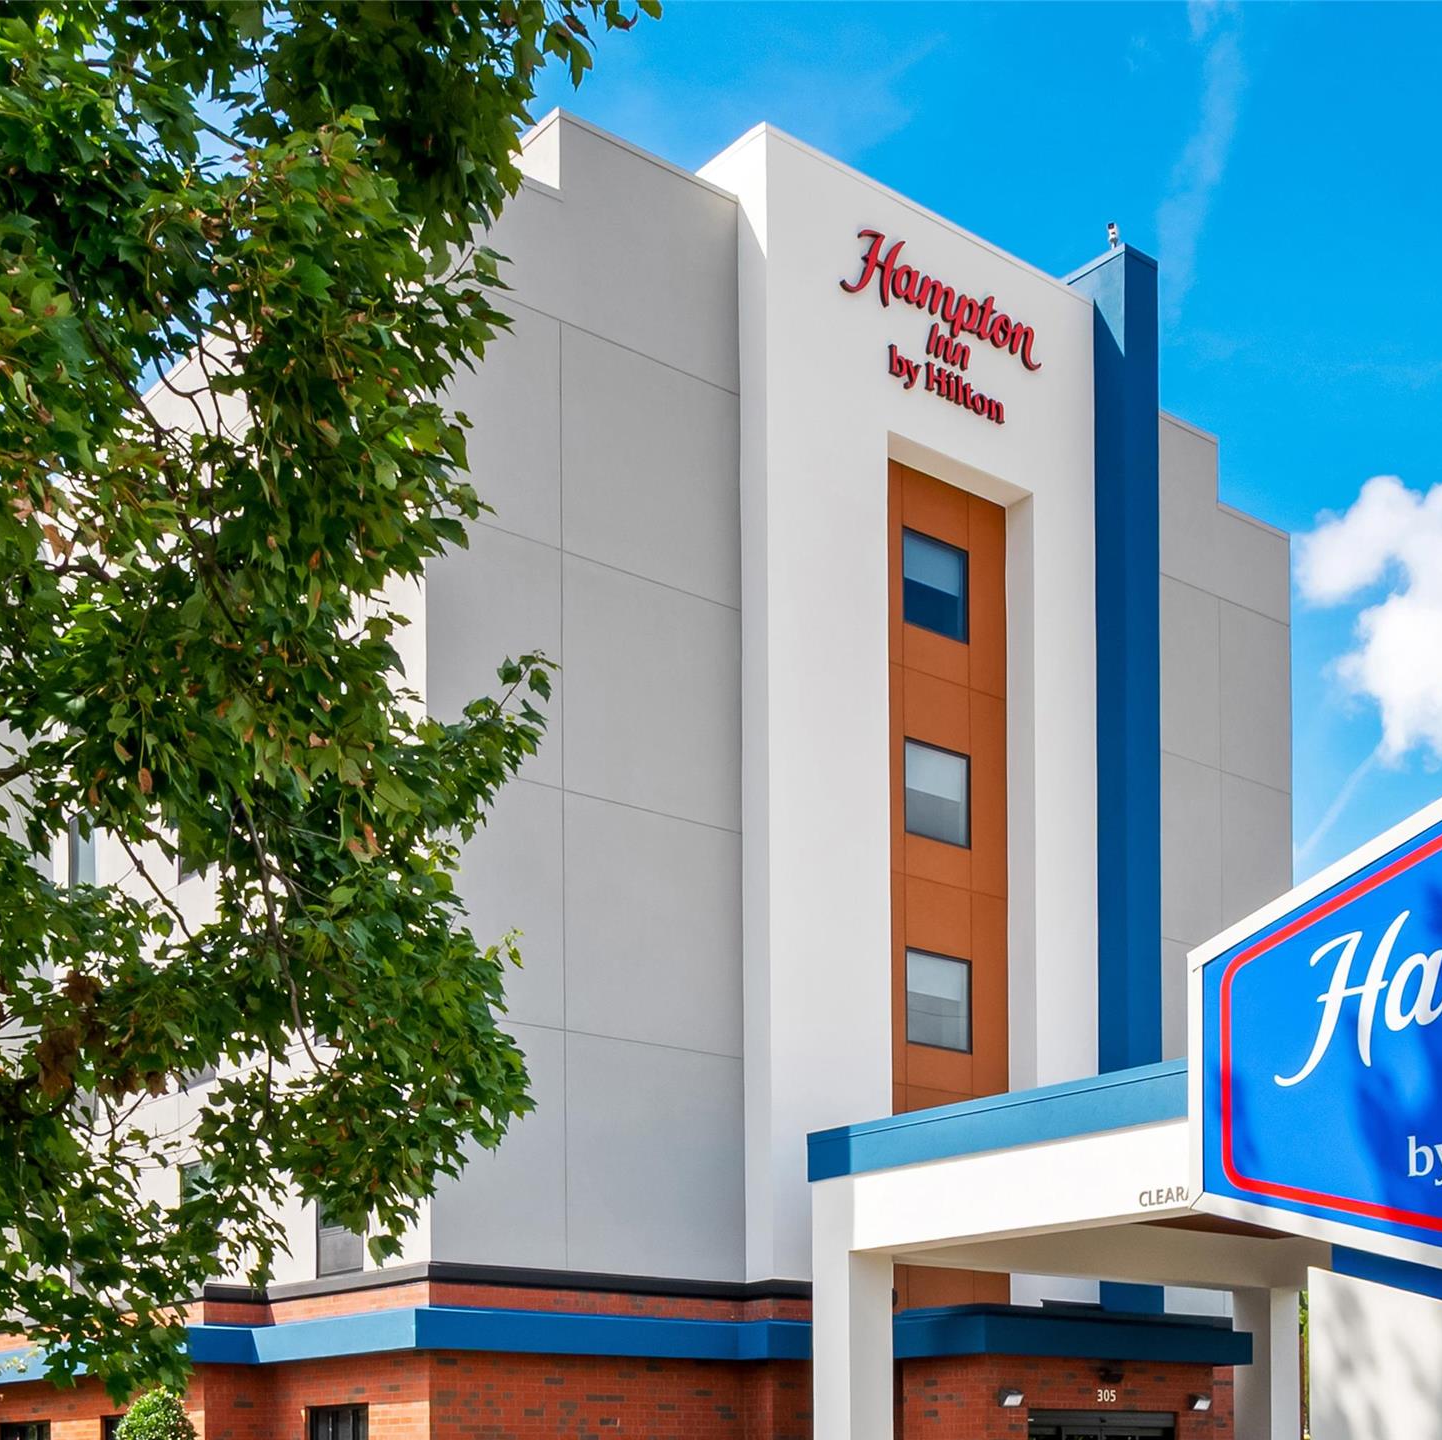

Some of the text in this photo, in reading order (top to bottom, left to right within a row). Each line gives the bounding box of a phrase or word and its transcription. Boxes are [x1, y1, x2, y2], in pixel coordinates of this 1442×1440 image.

[839, 229, 1042, 371] Hampton
[926, 322, 970, 370] Inn
[888, 343, 1006, 425] by Hilton
[1097, 1388, 1117, 1403] 305
